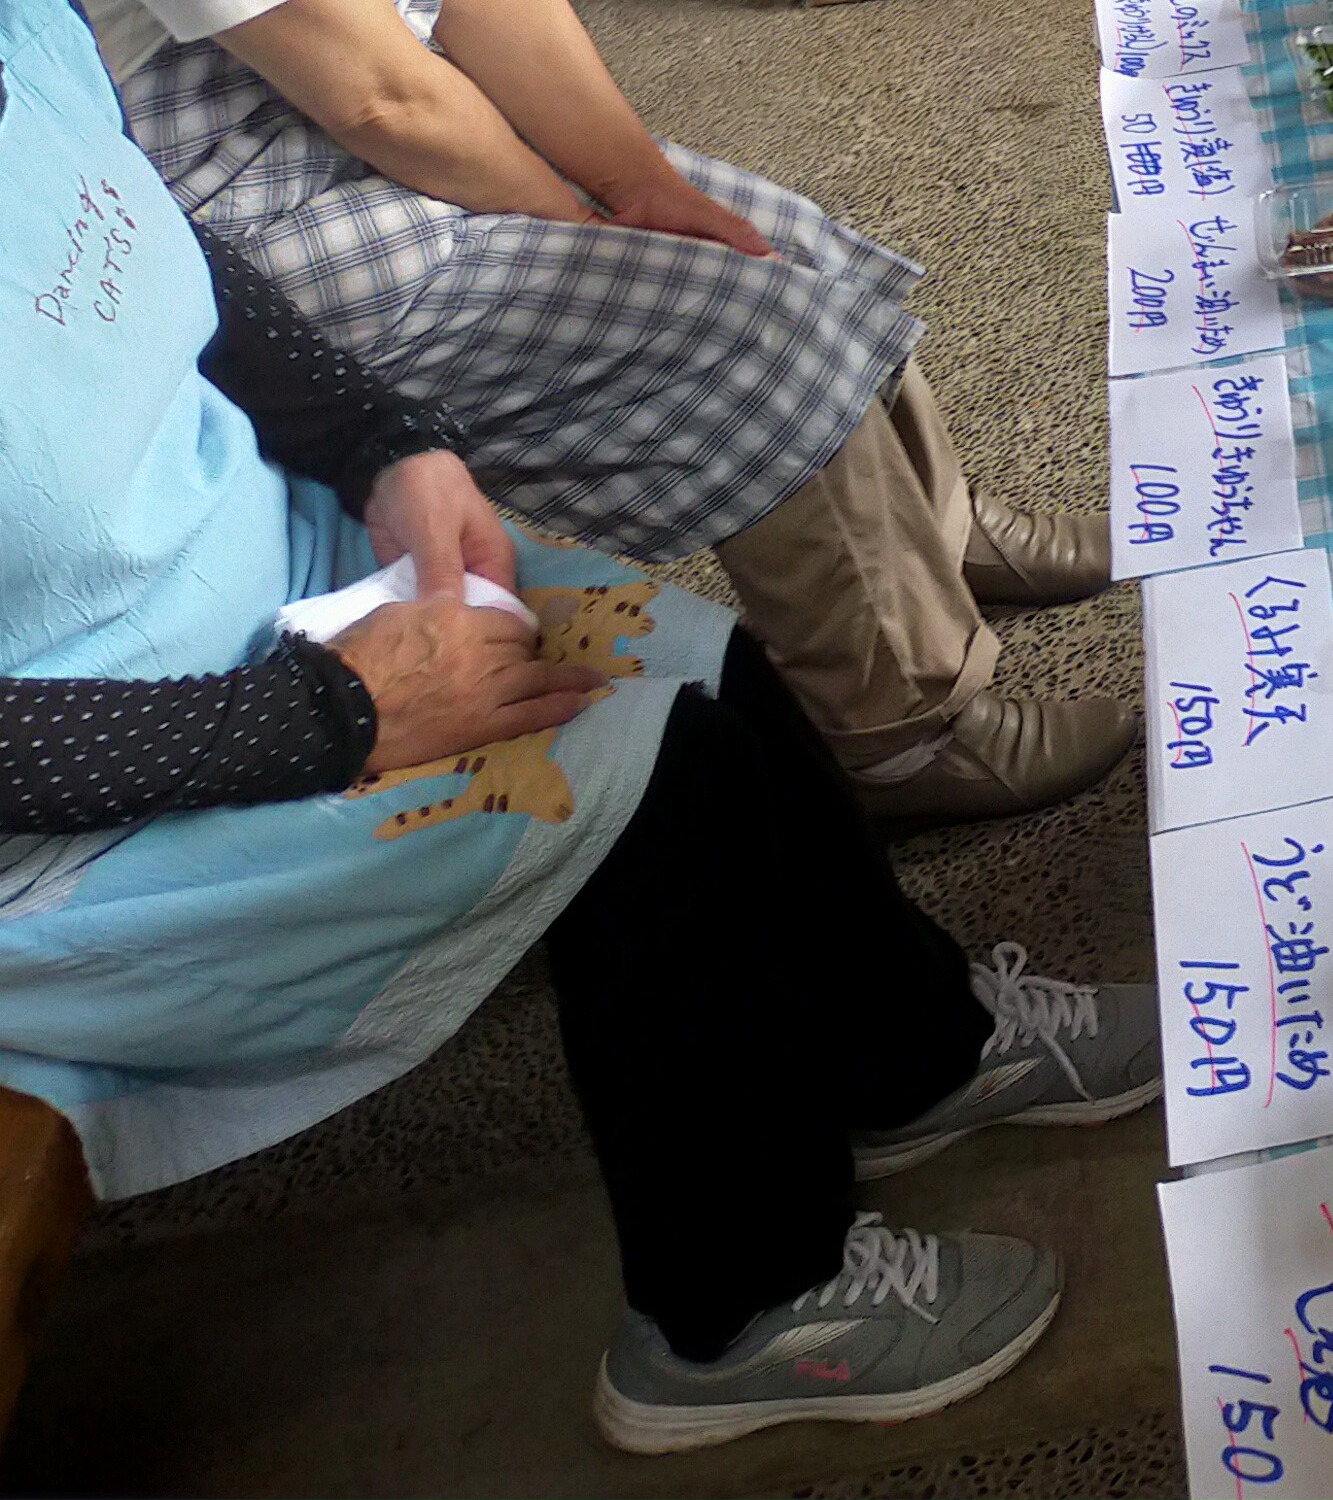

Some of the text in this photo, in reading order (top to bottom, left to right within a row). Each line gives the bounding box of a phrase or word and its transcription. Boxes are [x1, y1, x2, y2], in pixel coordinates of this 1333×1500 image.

[1126, 268, 1175, 328] 200円
[1128, 463, 1181, 545] 100円
[1242, 575, 1319, 747] くるみ寒天
[1166, 681, 1220, 769] 150円
[1178, 958, 1251, 1097] 150円
[1207, 1362, 1285, 1484] 150
